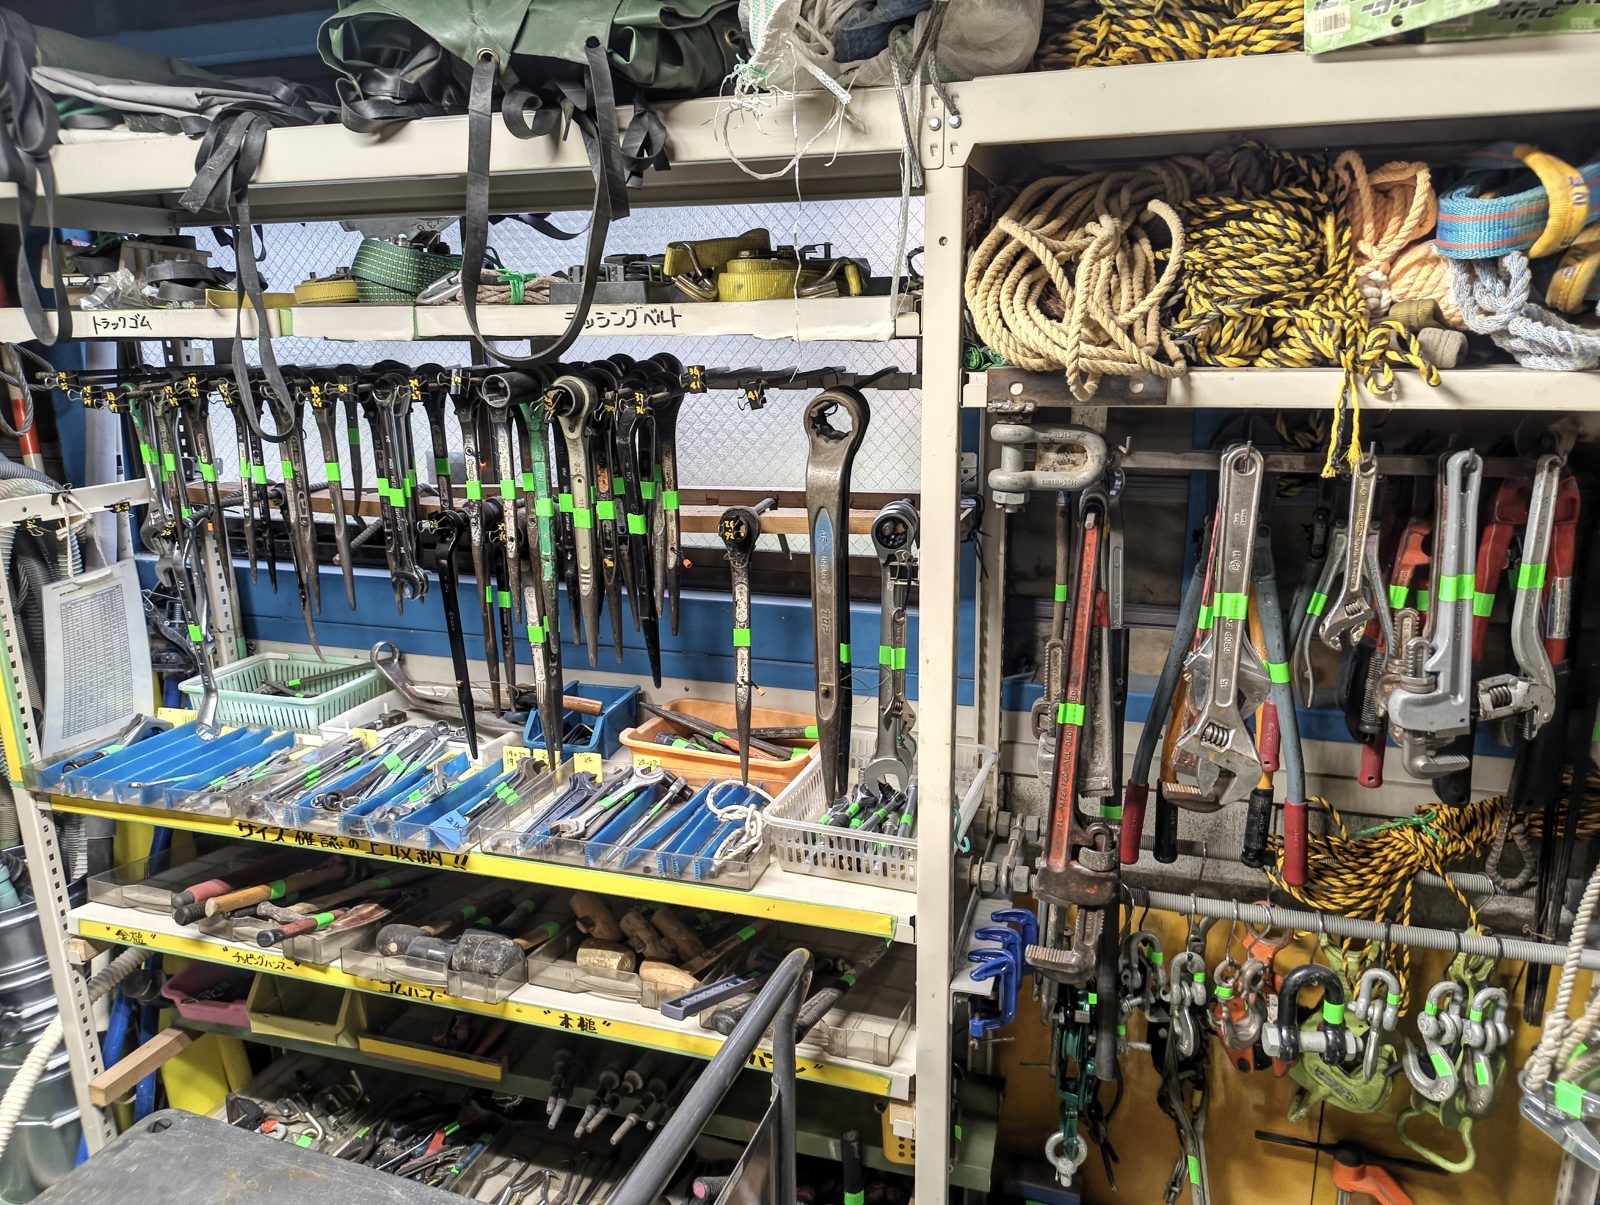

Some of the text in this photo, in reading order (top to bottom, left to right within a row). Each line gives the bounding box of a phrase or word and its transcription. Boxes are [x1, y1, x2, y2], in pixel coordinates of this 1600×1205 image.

[92, 313, 153, 335] トラックゴム
[820, 608, 830, 634] TOP
[1224, 632, 1234, 653] DROP
